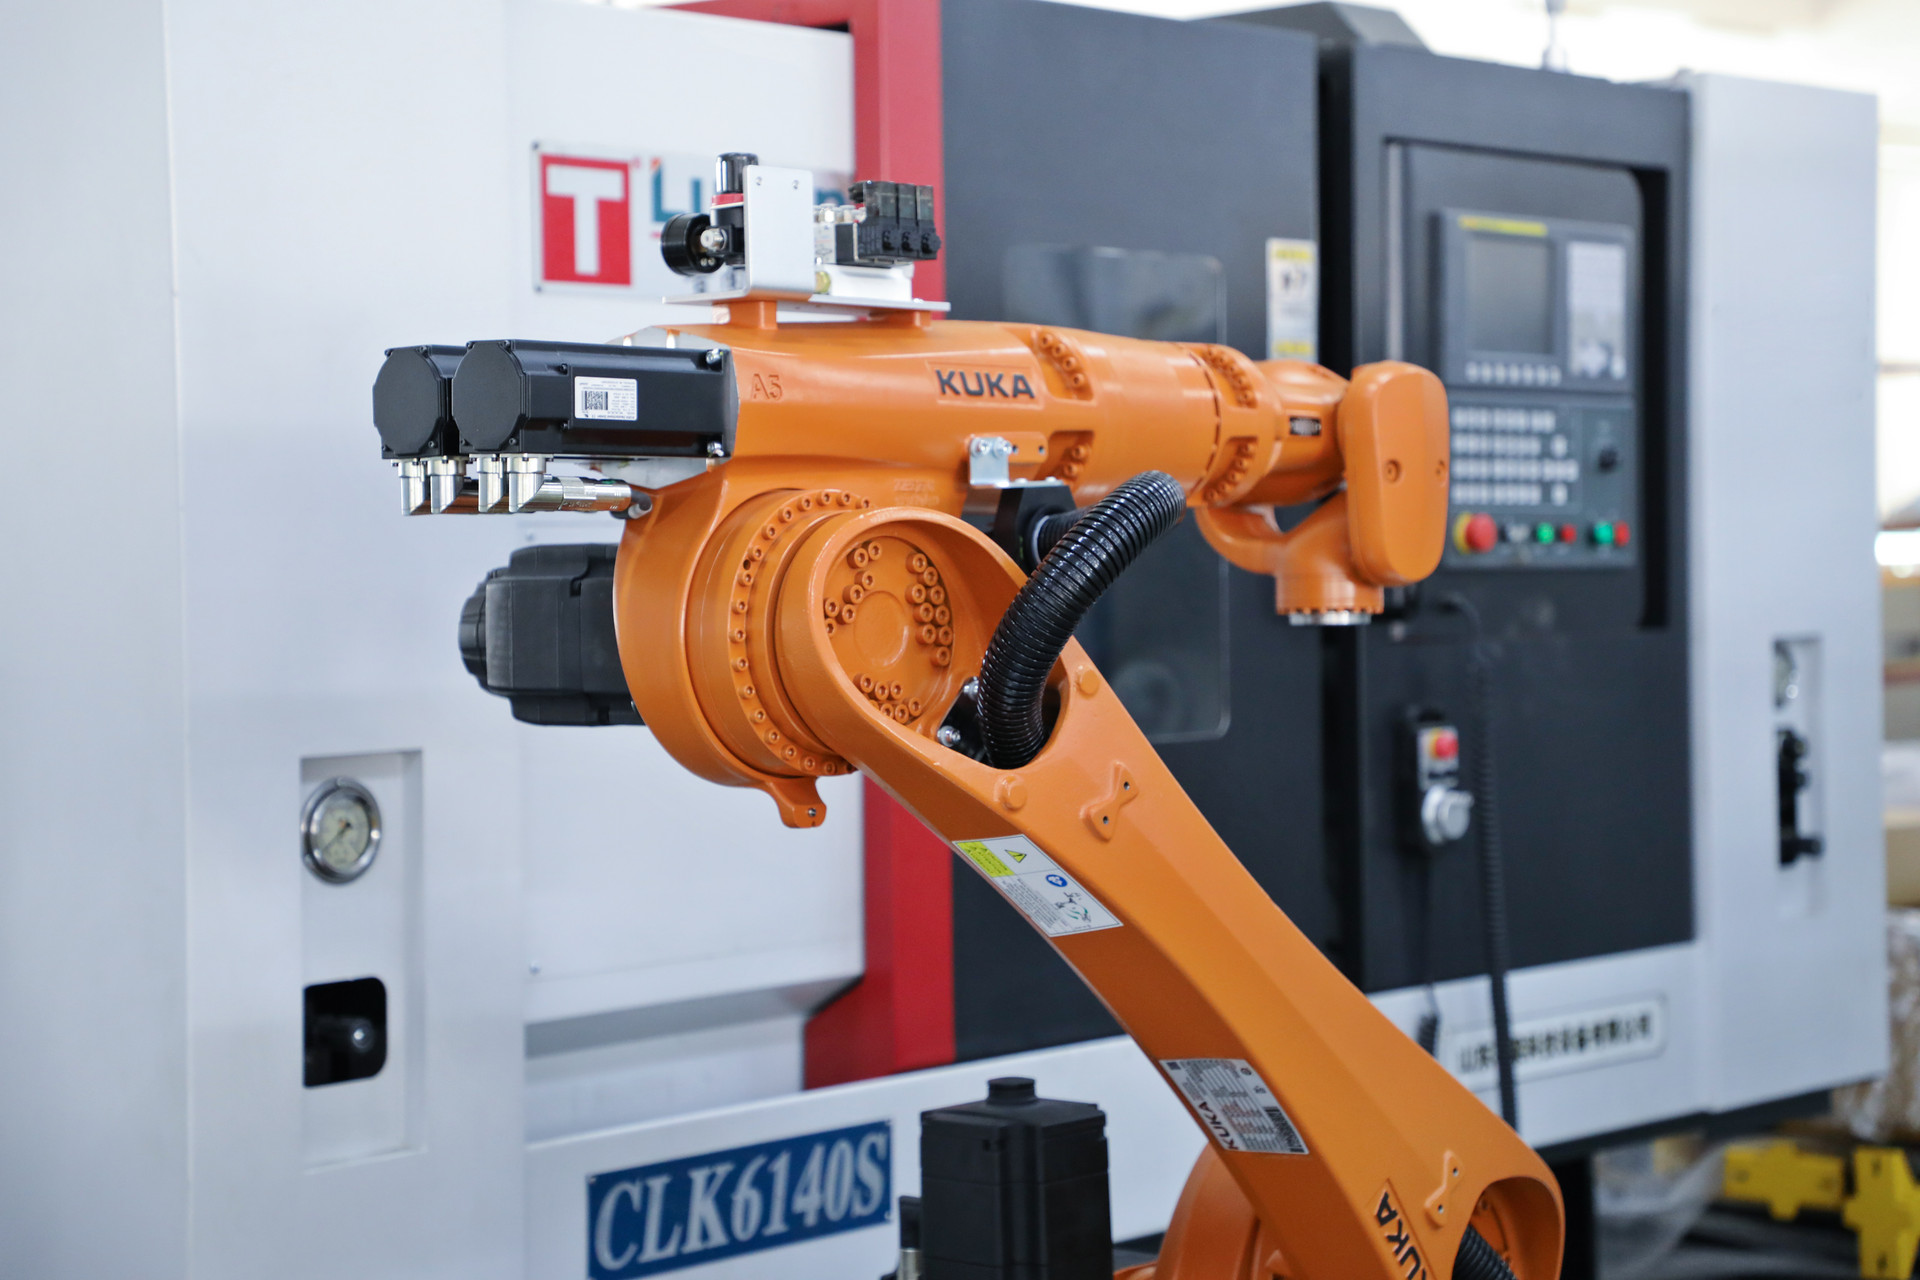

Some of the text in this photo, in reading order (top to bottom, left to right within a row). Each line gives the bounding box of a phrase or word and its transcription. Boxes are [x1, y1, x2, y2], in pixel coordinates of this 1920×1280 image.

[545, 163, 625, 276] T
[935, 369, 1036, 399] KUKA
[1198, 1101, 1239, 1151] KUKA
[594, 1131, 888, 1271] CLK6140S
[1375, 1191, 1427, 1280] UKA
